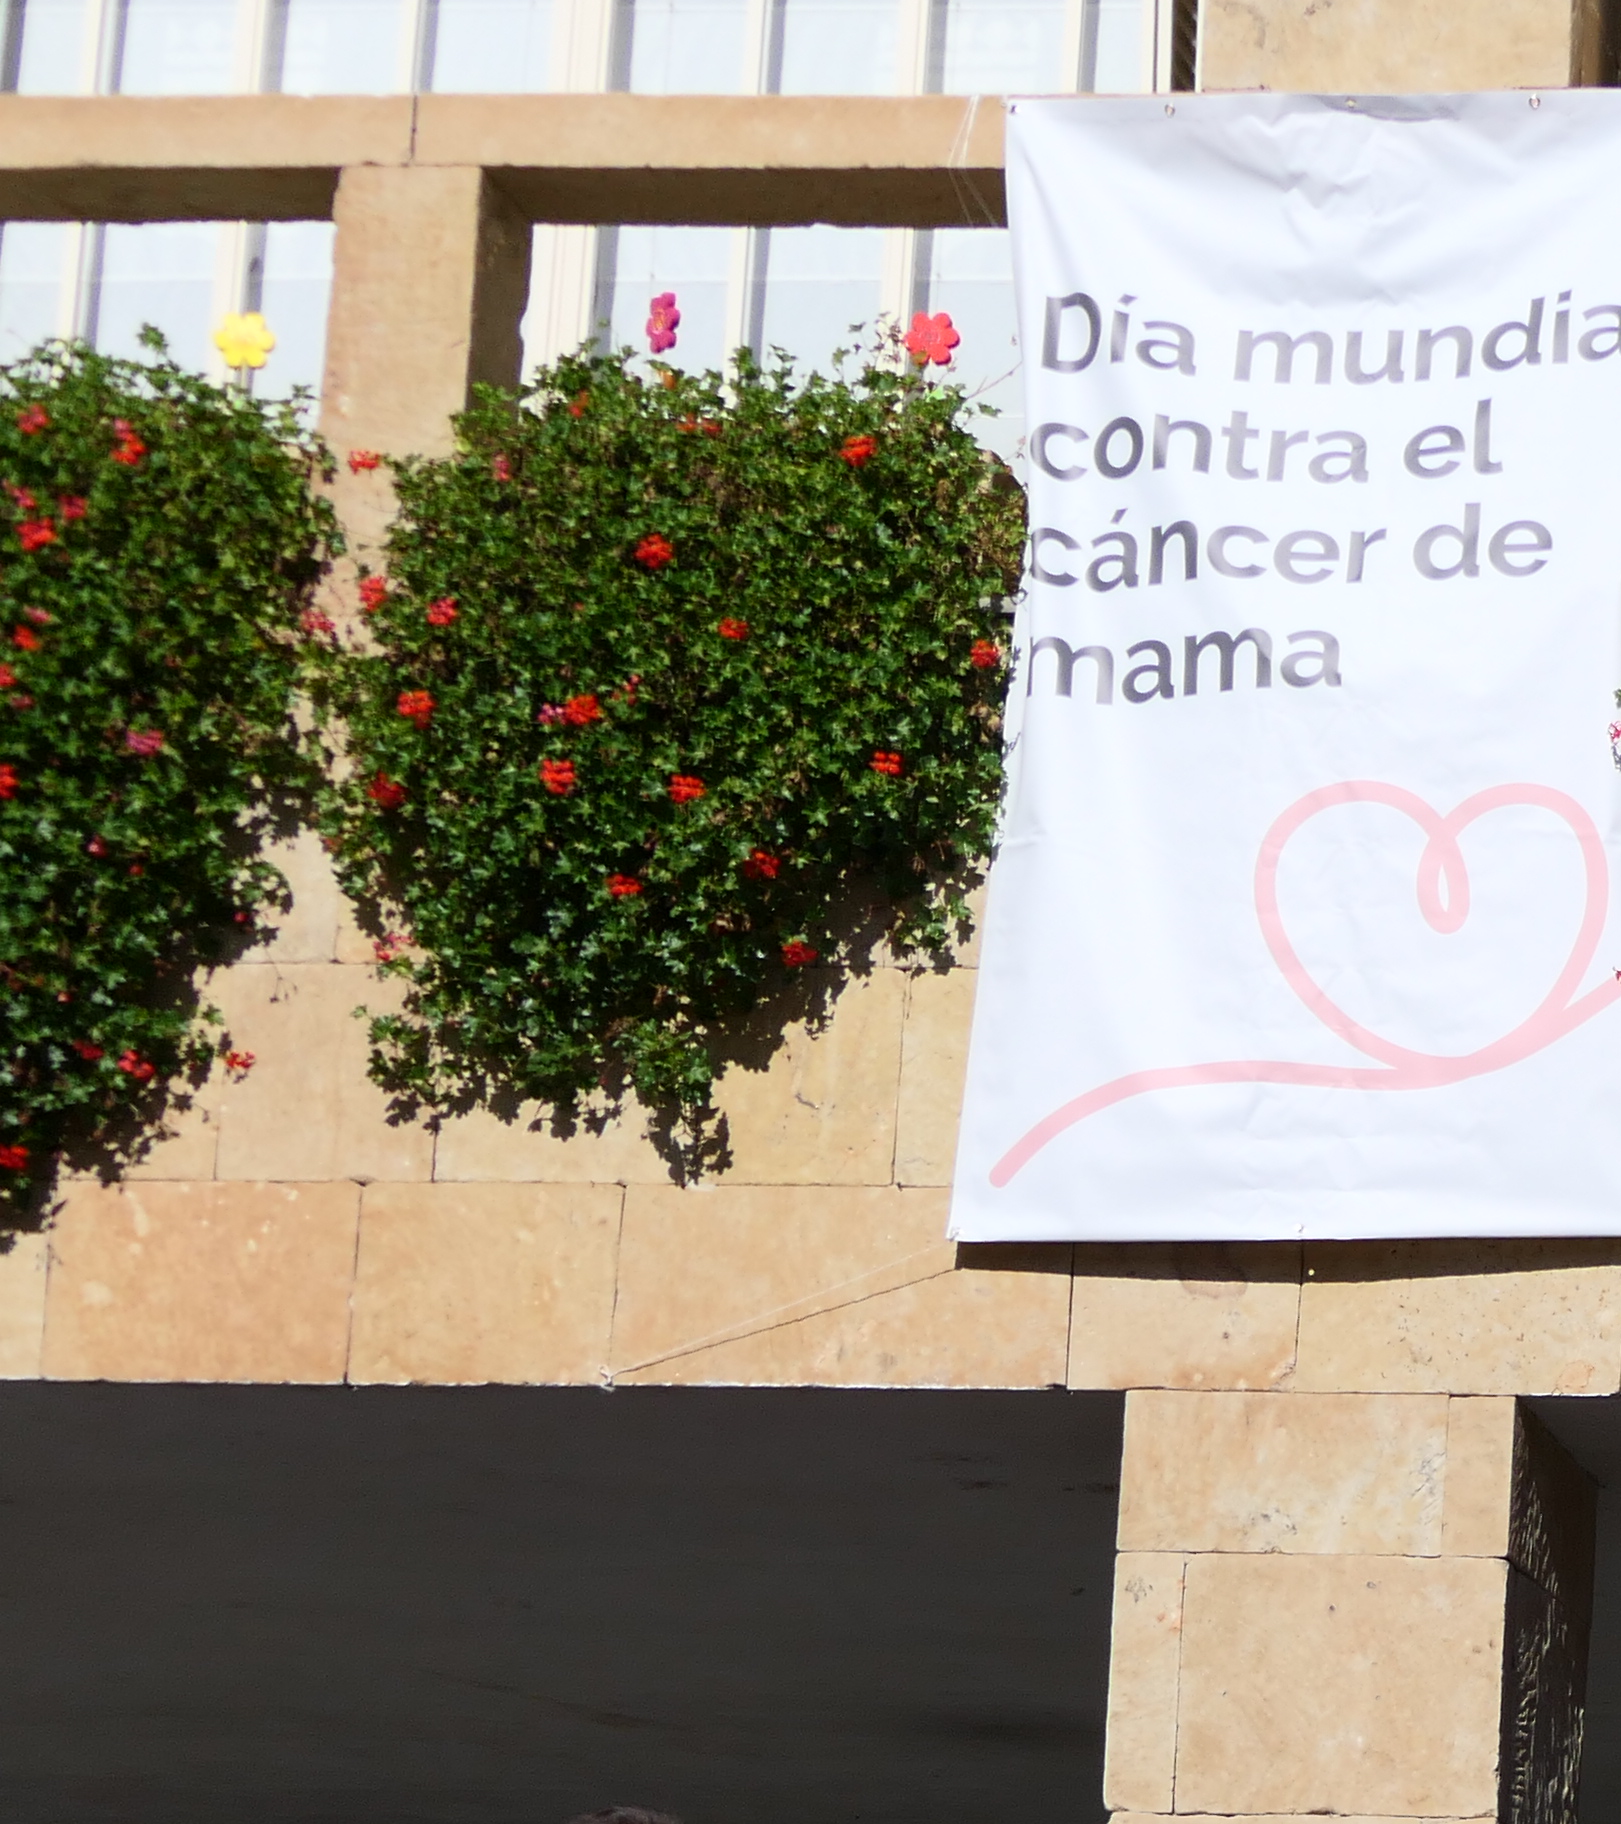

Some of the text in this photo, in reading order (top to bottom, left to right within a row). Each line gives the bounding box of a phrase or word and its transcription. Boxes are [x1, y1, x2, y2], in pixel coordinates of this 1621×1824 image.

[1040, 290, 1198, 376] Día
[1029, 397, 1503, 484] contra el
[1030, 502, 1553, 593] cáncer de
[1027, 627, 1342, 705] mama
